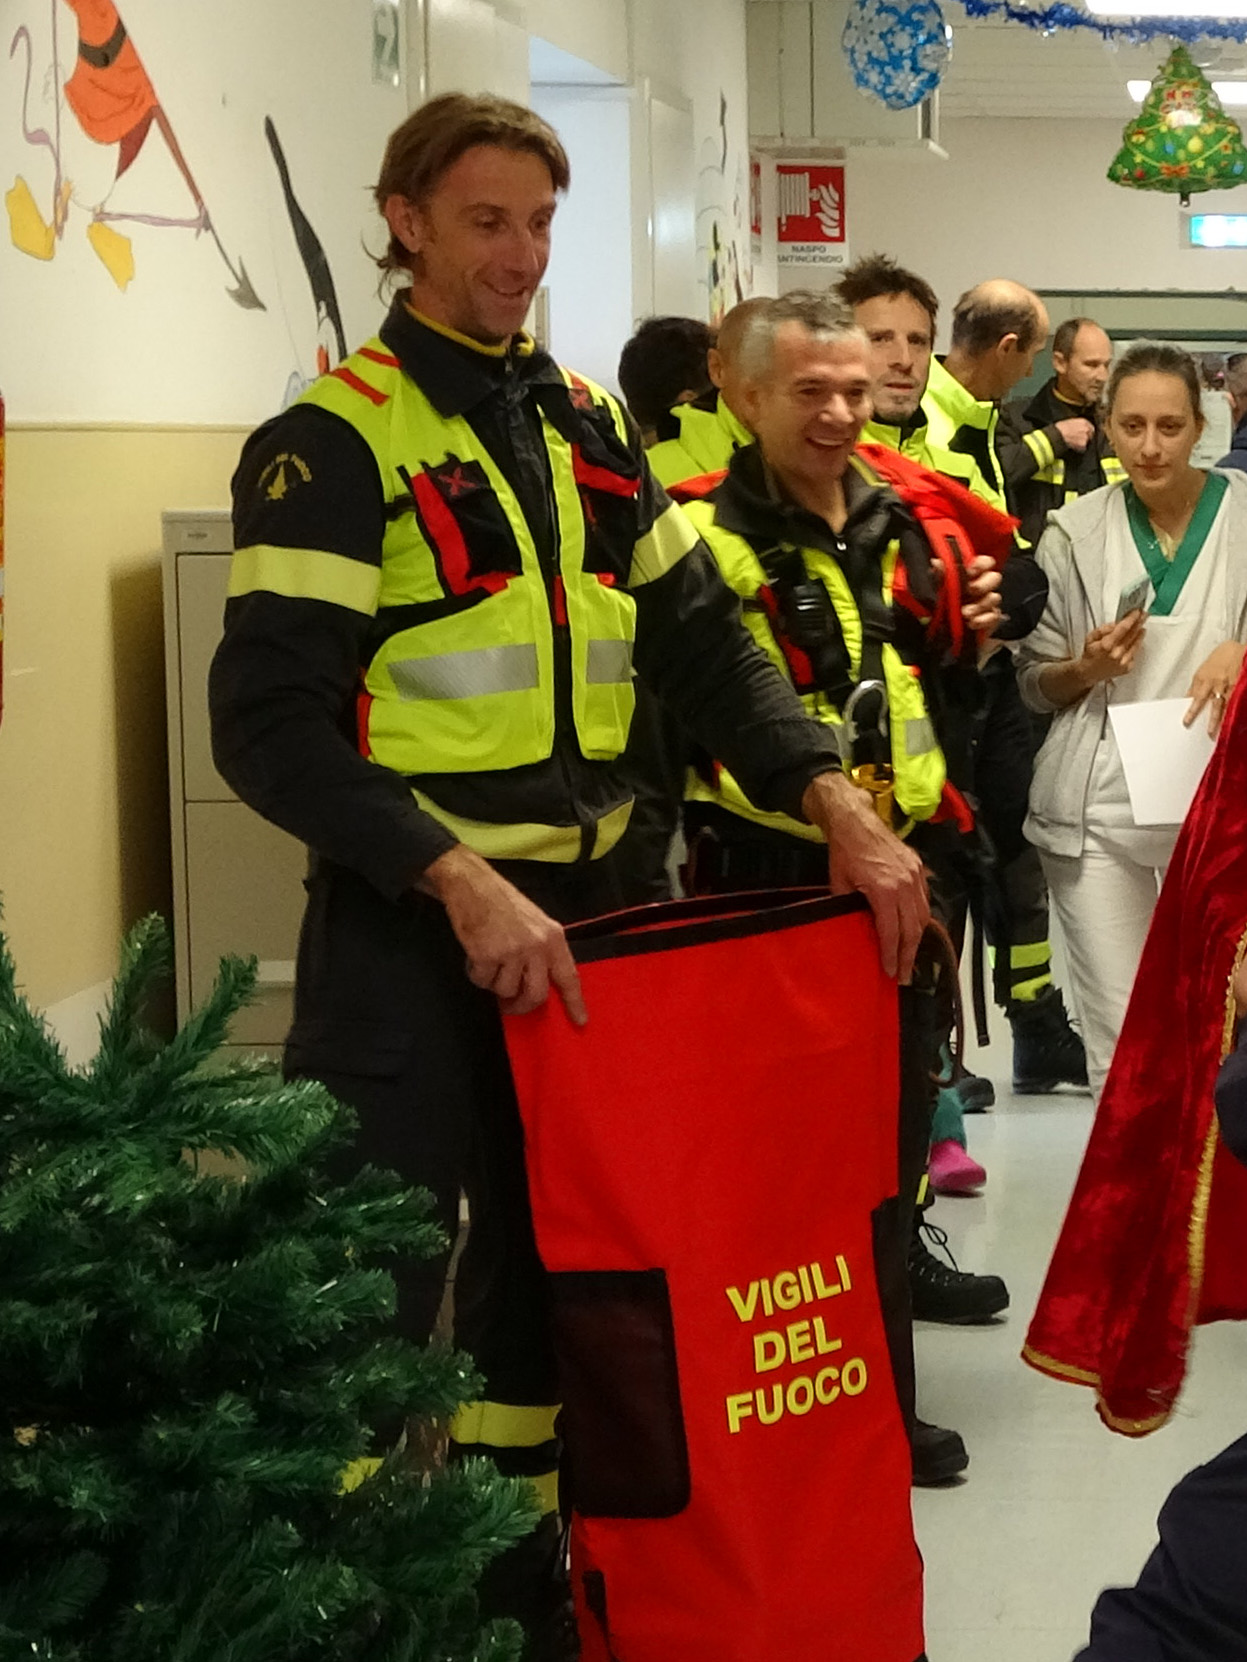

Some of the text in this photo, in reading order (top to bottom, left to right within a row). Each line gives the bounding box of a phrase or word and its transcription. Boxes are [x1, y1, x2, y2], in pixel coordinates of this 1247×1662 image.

[791, 245, 827, 253] NASPO
[725, 1254, 853, 1323] VIGILI
[753, 1315, 843, 1374] DEL
[725, 1356, 868, 1434] FUOCO
